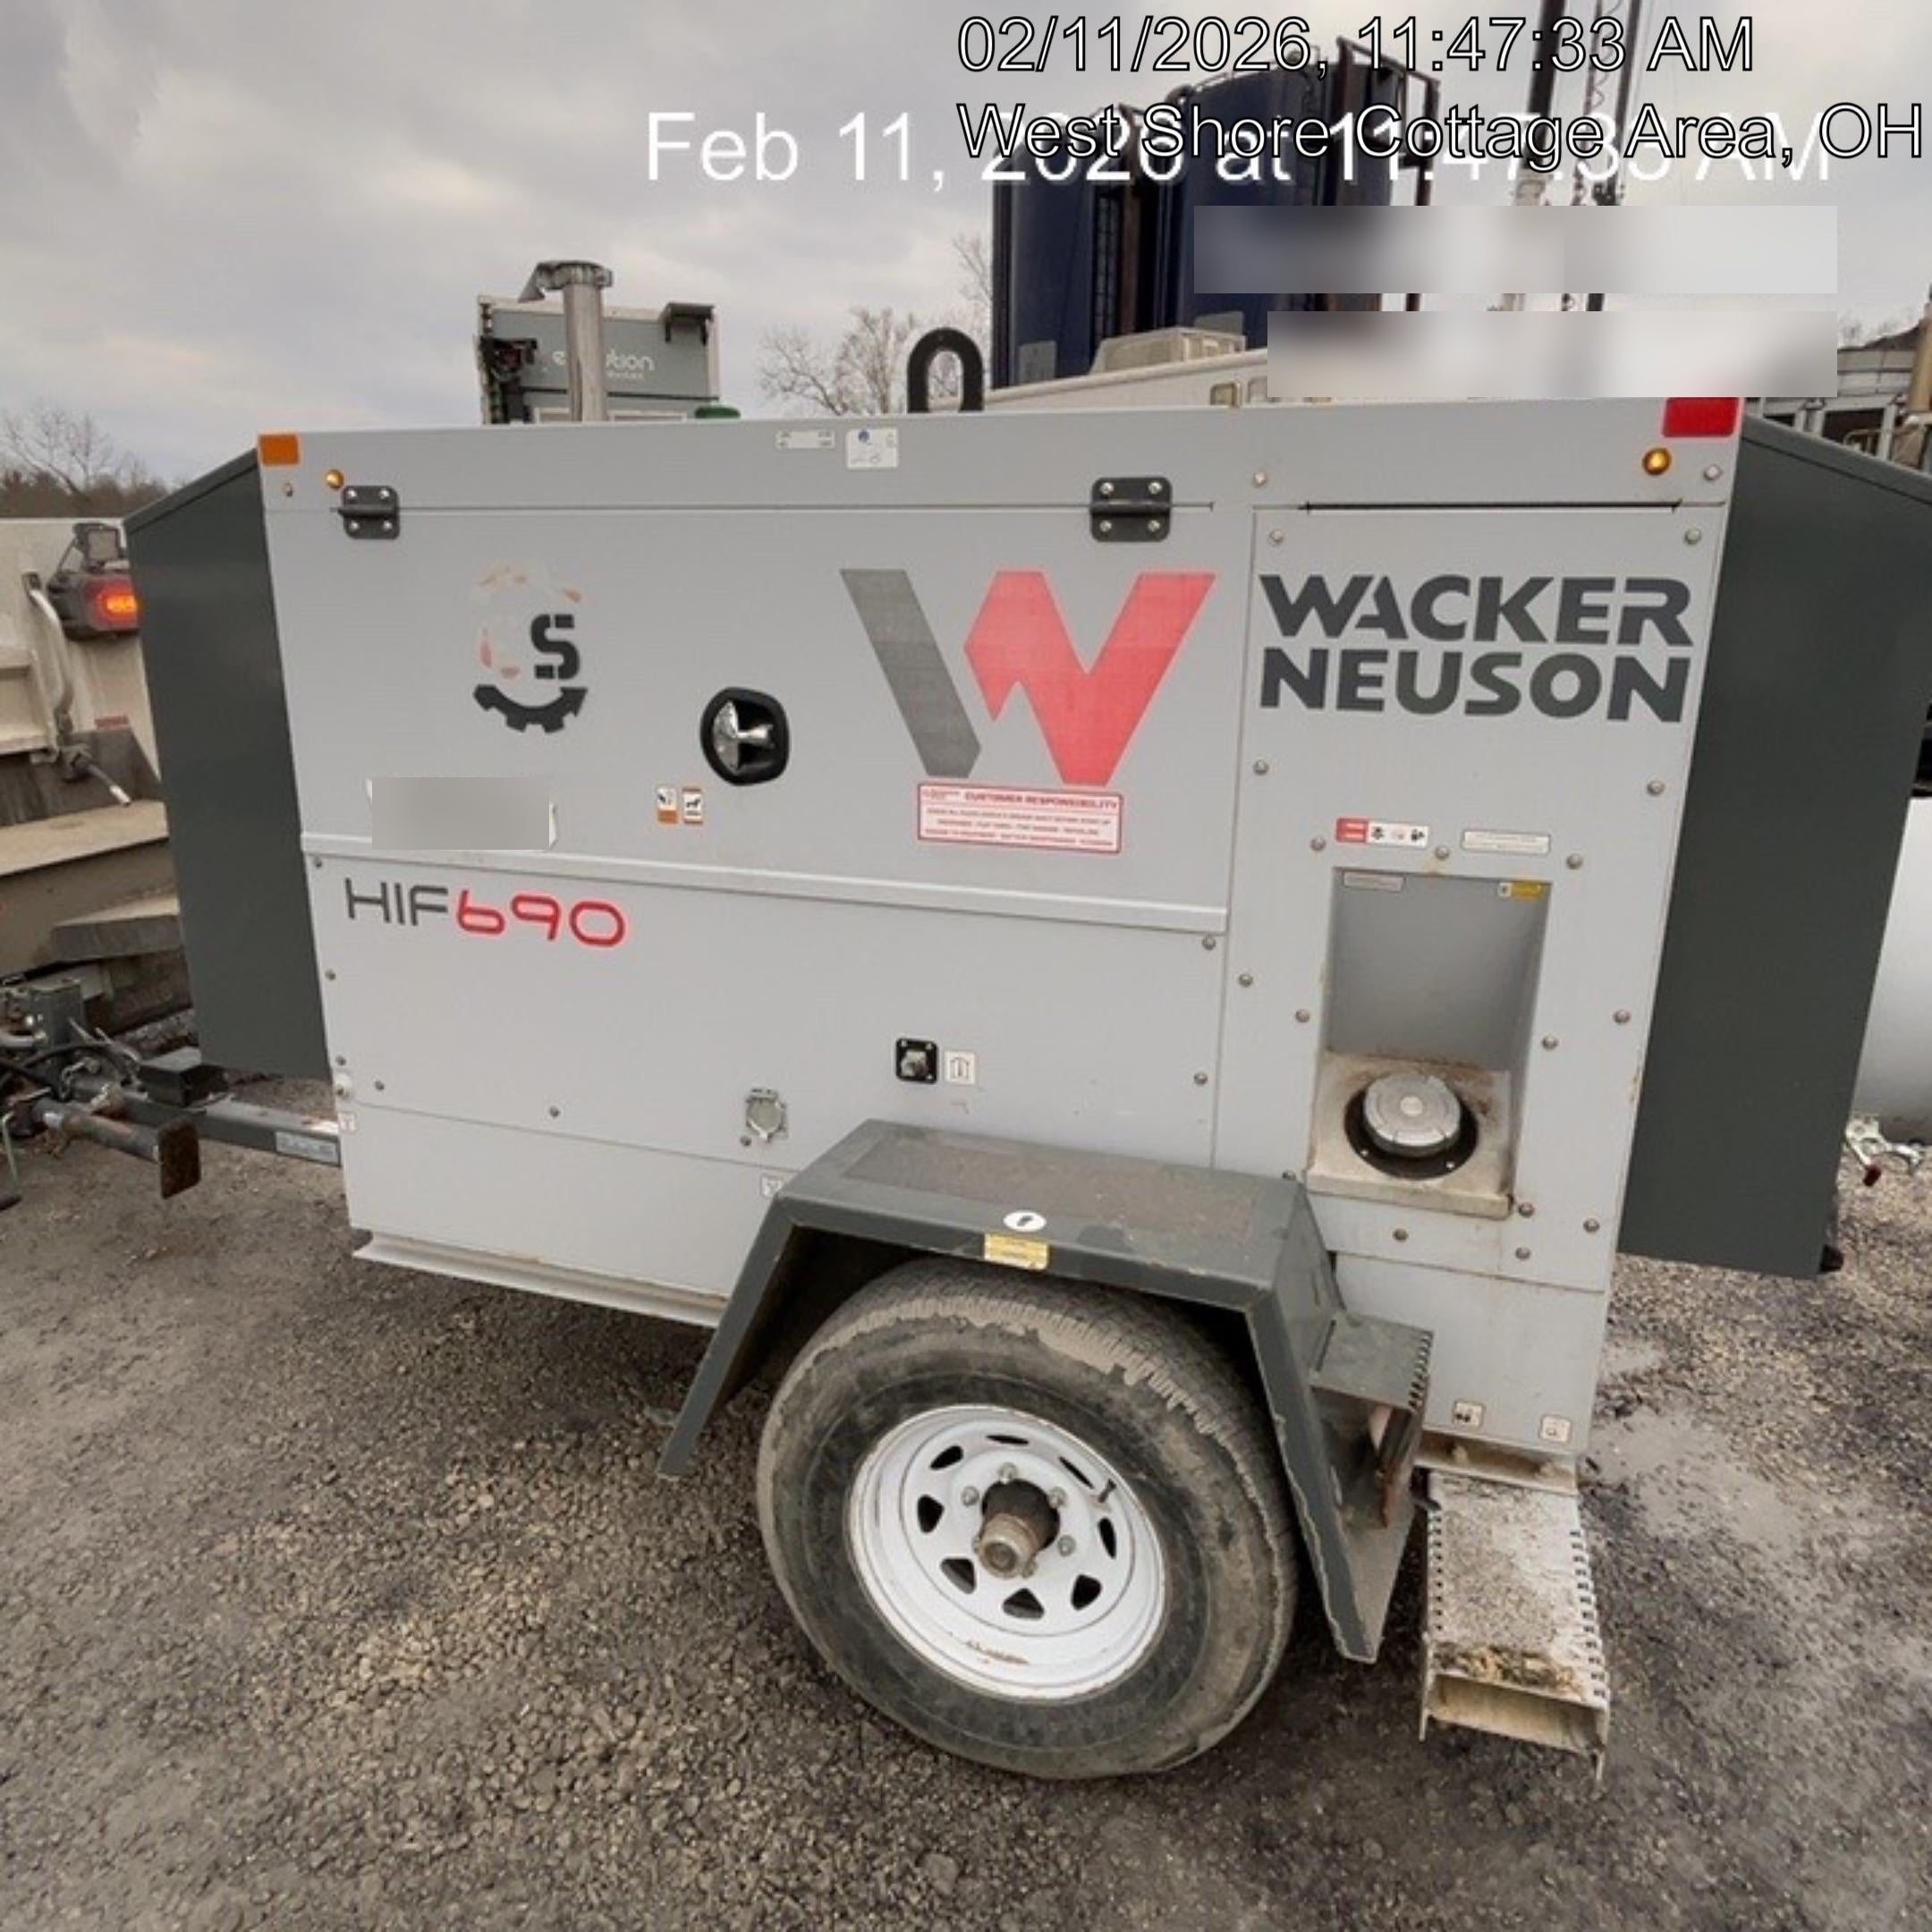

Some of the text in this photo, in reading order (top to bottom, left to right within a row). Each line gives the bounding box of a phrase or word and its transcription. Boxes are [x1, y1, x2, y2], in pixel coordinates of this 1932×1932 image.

[1258, 573, 1694, 647] WACKER
[1259, 648, 1691, 723] NEUSON
[1024, 794, 1118, 809] RESPONSIBILITY
